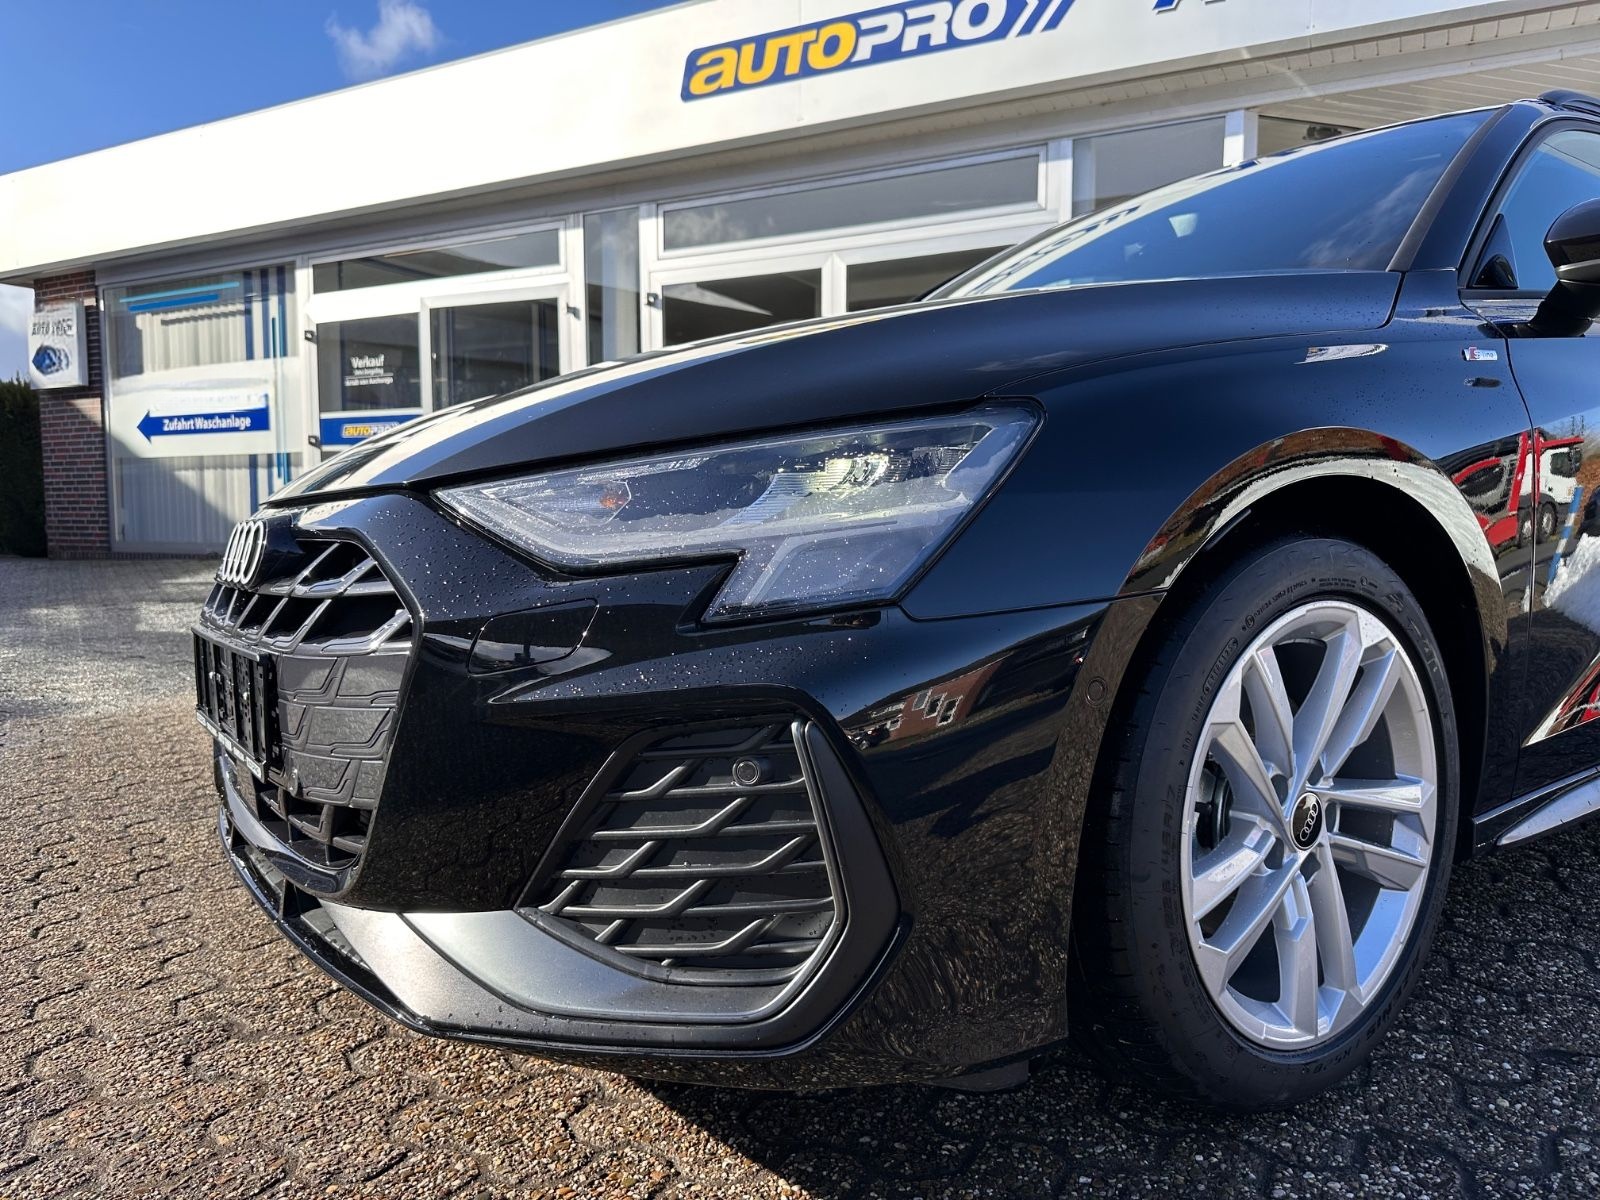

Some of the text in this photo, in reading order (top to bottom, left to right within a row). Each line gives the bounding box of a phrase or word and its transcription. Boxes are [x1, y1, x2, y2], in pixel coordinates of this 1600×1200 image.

[350, 354, 384, 369] Verkauf
[163, 414, 251, 431] Zufahrt Waschanlage
